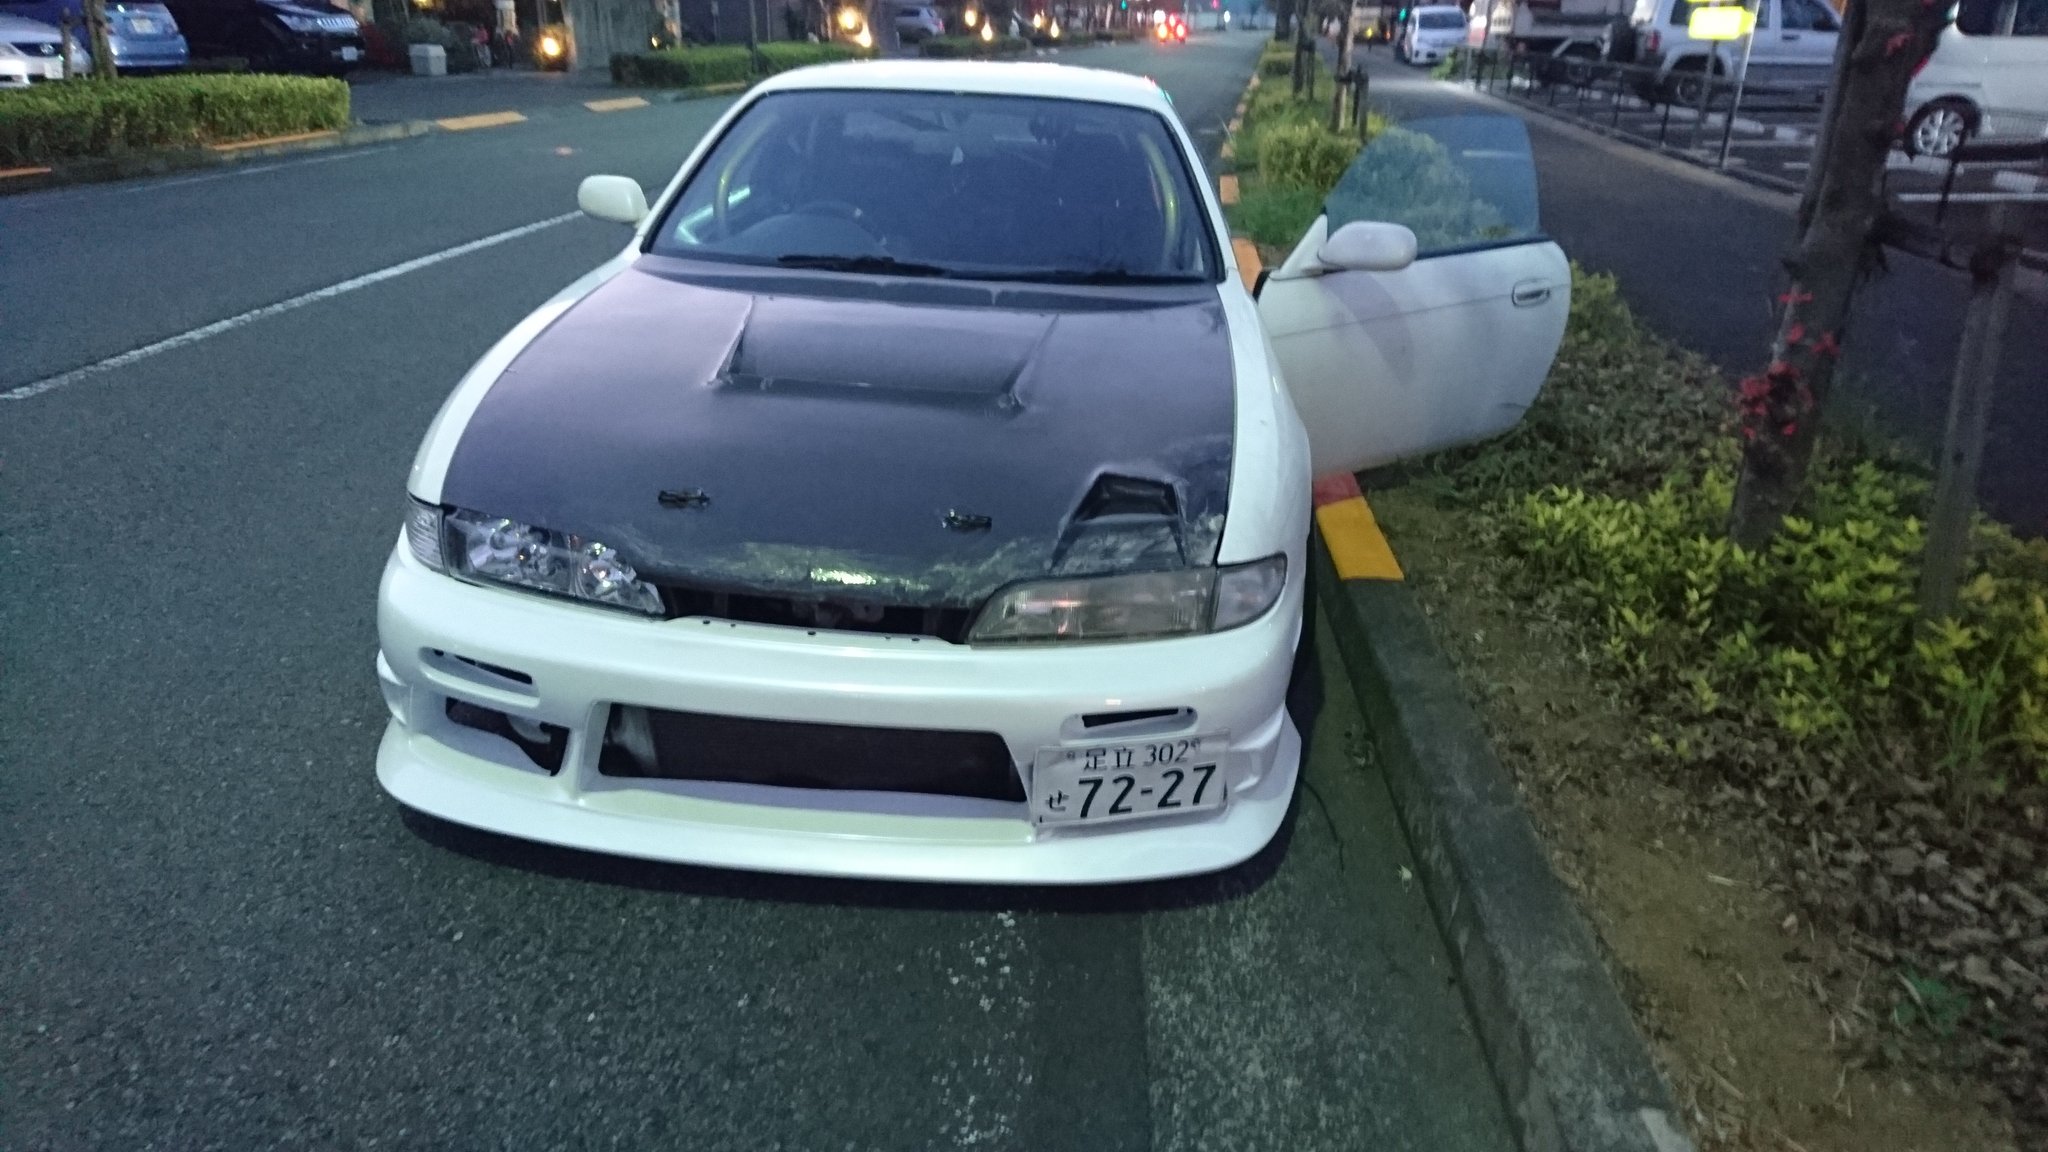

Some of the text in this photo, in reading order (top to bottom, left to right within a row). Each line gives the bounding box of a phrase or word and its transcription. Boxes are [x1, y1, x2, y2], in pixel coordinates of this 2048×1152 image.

[1083, 739, 1188, 770] 足立 302
[1046, 763, 1217, 818] せ 72-27
